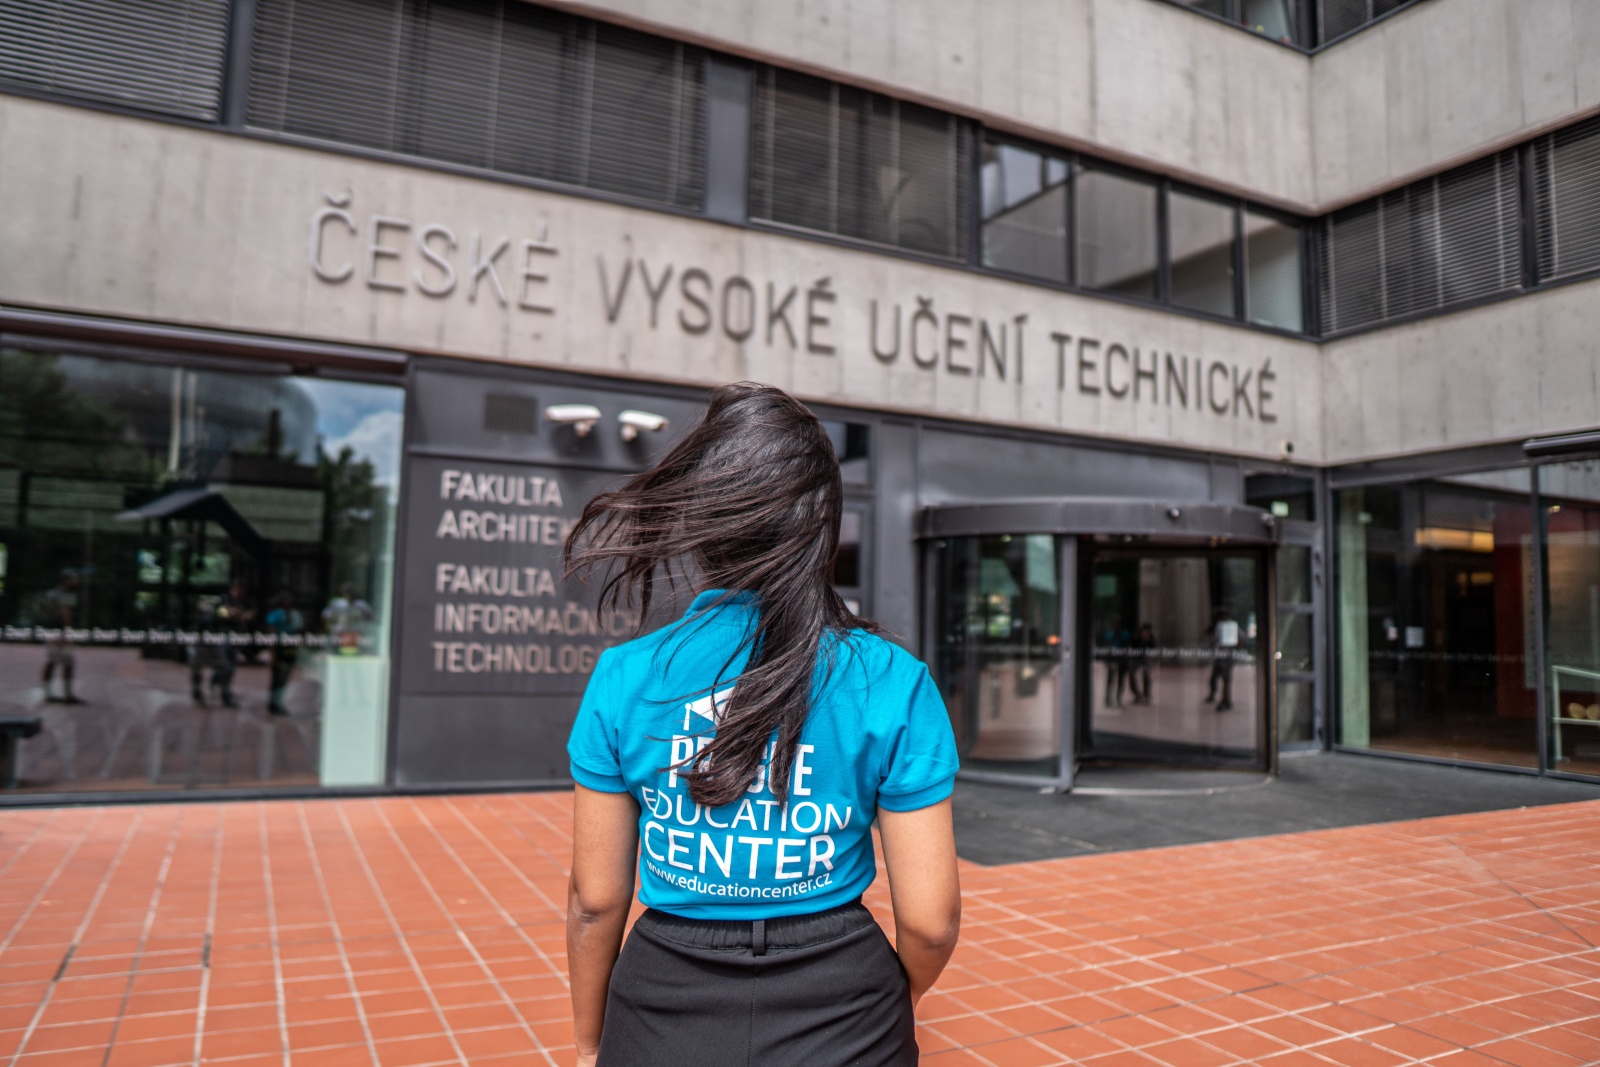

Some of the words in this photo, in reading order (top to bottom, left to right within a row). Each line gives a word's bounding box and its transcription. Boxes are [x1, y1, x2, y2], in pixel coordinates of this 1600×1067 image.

[309, 189, 559, 315] ČESKÉ
[596, 253, 837, 354] VYSOKÉ
[870, 294, 1028, 384] UČENÍ
[1051, 331, 1277, 422] TECHNICKÉ
[440, 470, 563, 507] FAKULTA
[435, 563, 556, 597] FAKULTA
[432, 639, 613, 674] TECHNOLOG
[641, 786, 852, 834] EDUCATION
[644, 820, 836, 880] CENTER
[646, 859, 833, 898] www.educationcenter.cz
